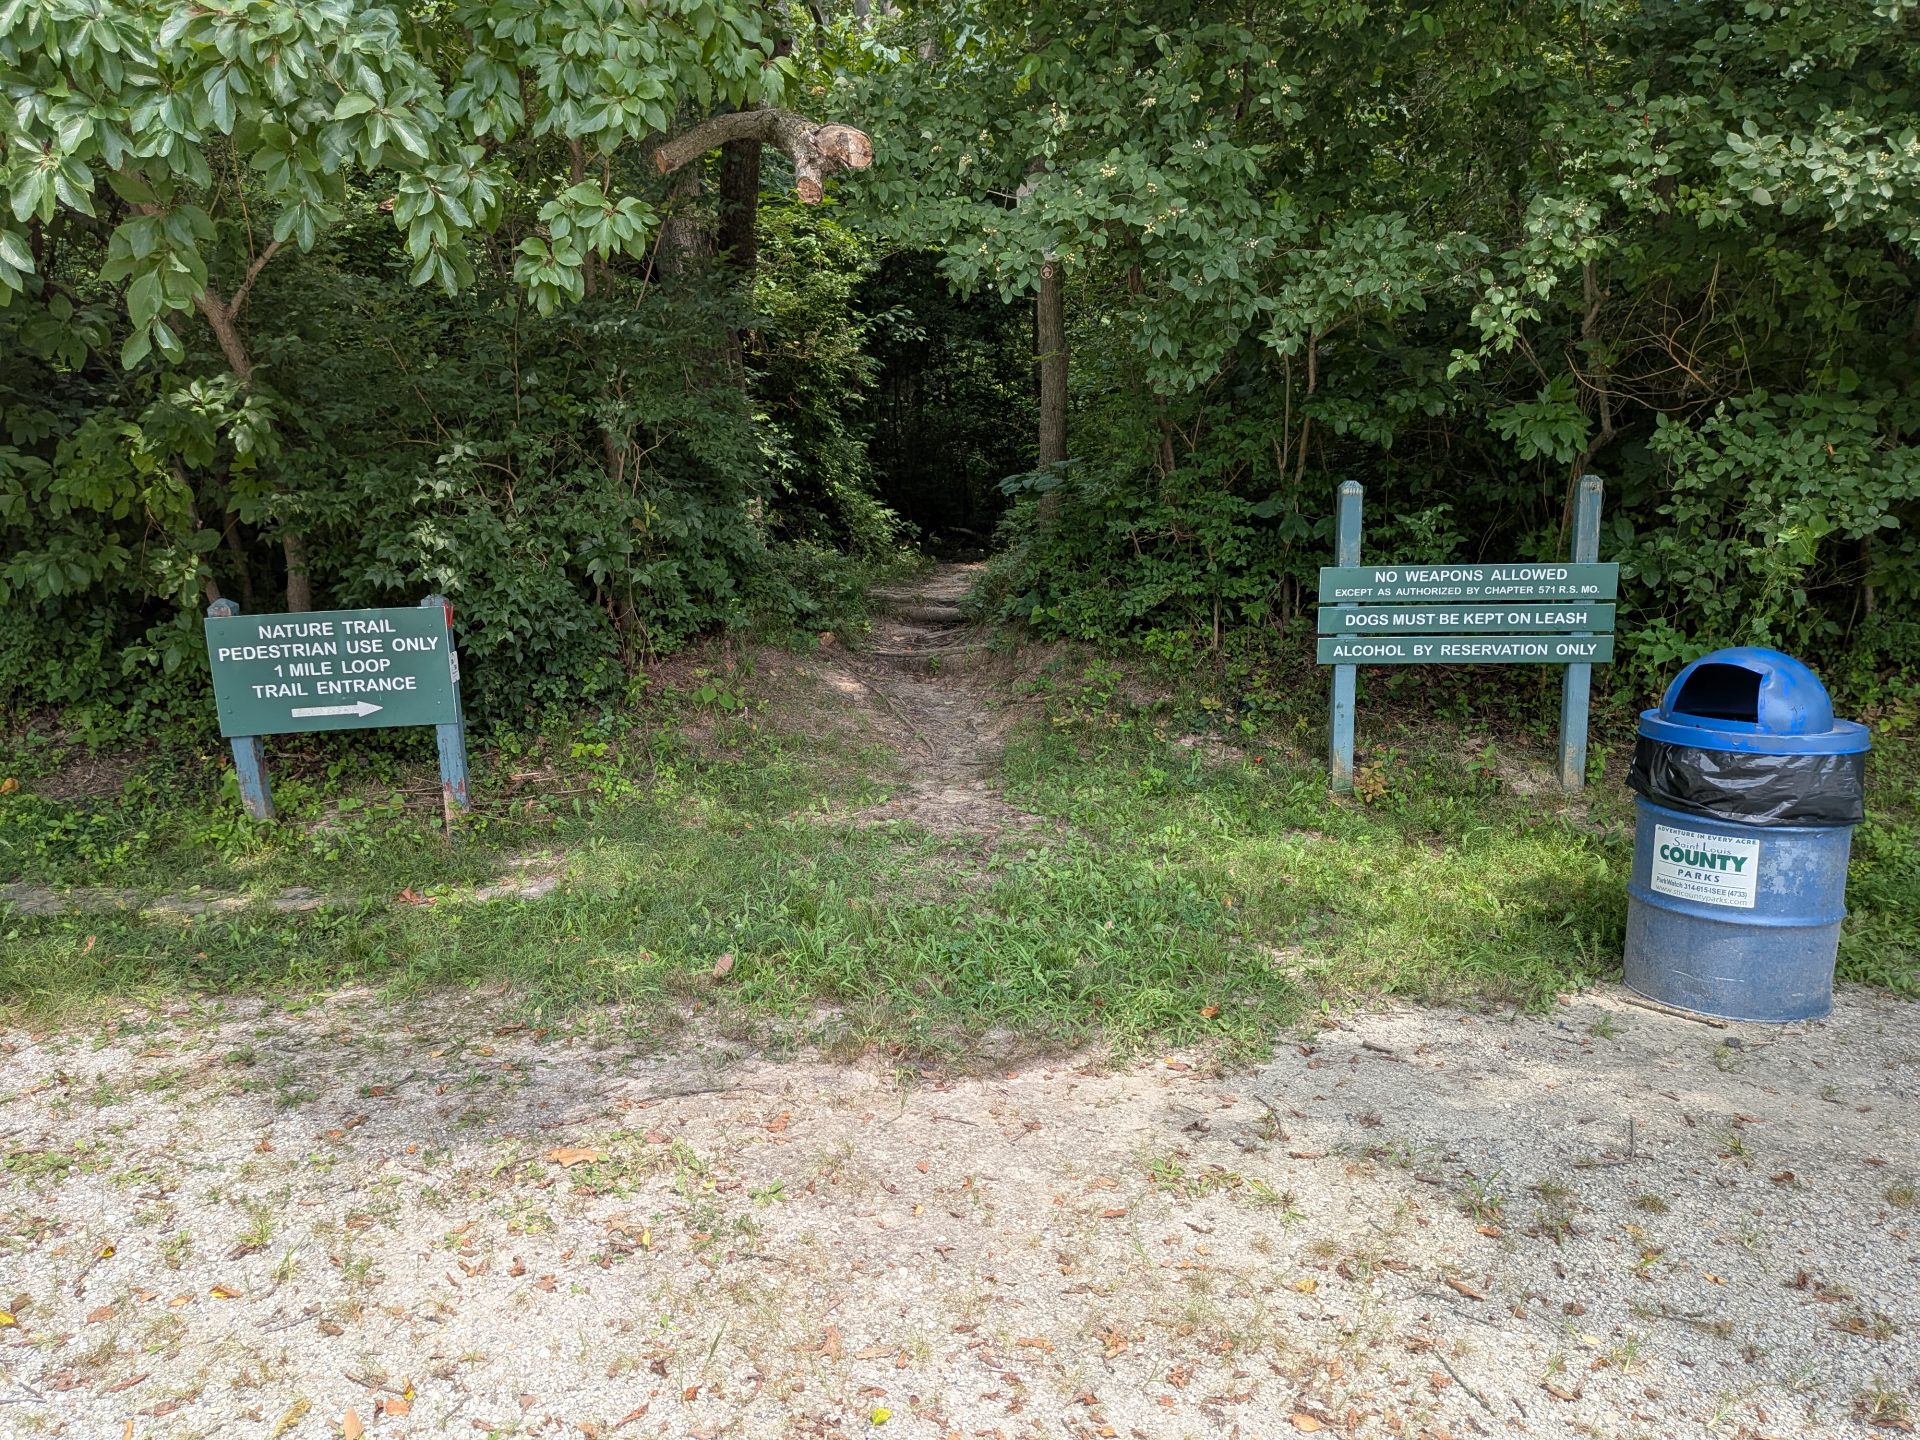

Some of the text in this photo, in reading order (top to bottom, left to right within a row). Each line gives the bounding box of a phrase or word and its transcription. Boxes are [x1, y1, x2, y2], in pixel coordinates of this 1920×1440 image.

[1375, 568, 1568, 582] NO WEAPONS ALLOWED
[1335, 585, 1600, 596] EXCEPT AS AUTHORIZED BY CHAPTER 571 R.S. MO.
[1346, 612, 1587, 626] DOGS MUST BE KEPT ON LEASH
[258, 619, 396, 639] NATURE TRAIL
[219, 637, 438, 661] PEDESTRIAN USE ONLY
[1334, 644, 1596, 656] ALCOHOL BY RESERVATION ONLY
[274, 659, 391, 677] 1 MILE LOOP
[252, 677, 416, 698] TRAIL ENTRANCE
[1658, 826, 1694, 838] ADVENTURE
[1672, 837, 1731, 855] Saint Louis
[1660, 844, 1748, 872] COUNTY
[1678, 869, 1720, 882] PARKS
